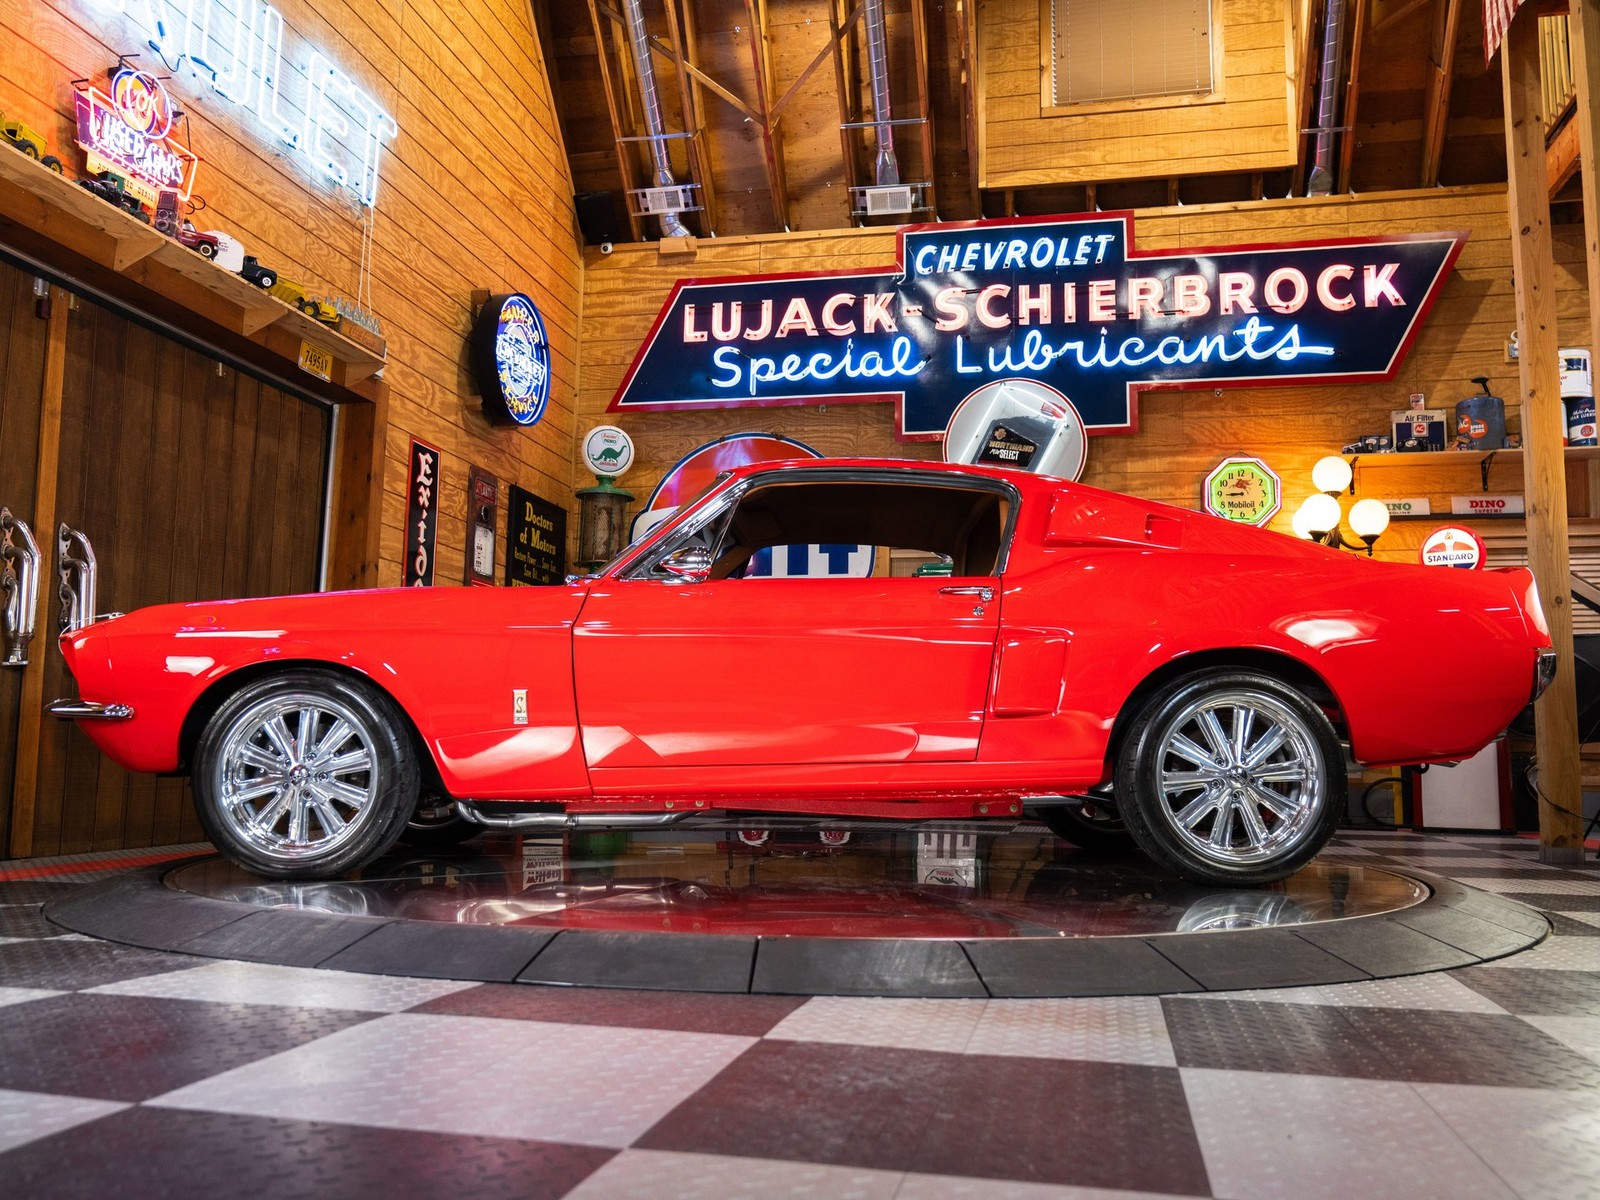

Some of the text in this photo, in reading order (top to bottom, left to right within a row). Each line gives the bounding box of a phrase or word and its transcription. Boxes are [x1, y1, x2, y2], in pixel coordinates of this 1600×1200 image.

[98, 110, 184, 186] USED CARS
[915, 233, 1115, 275] CHEVROLET
[709, 316, 1335, 396] Special Lubricants
[1458, 418, 1469, 429] AC
[988, 440, 1035, 453] NORTHLAND
[999, 449, 1020, 460] SELECT
[1237, 469, 1245, 477] 12
[1217, 490, 1222, 498] 9
[1220, 501, 1225, 509] 8
[1386, 503, 1412, 511] INO
[1469, 499, 1506, 508] DINO
[525, 501, 553, 531] Doctors
[520, 527, 556, 555] of Motors
[1427, 552, 1474, 563] STANDARD
